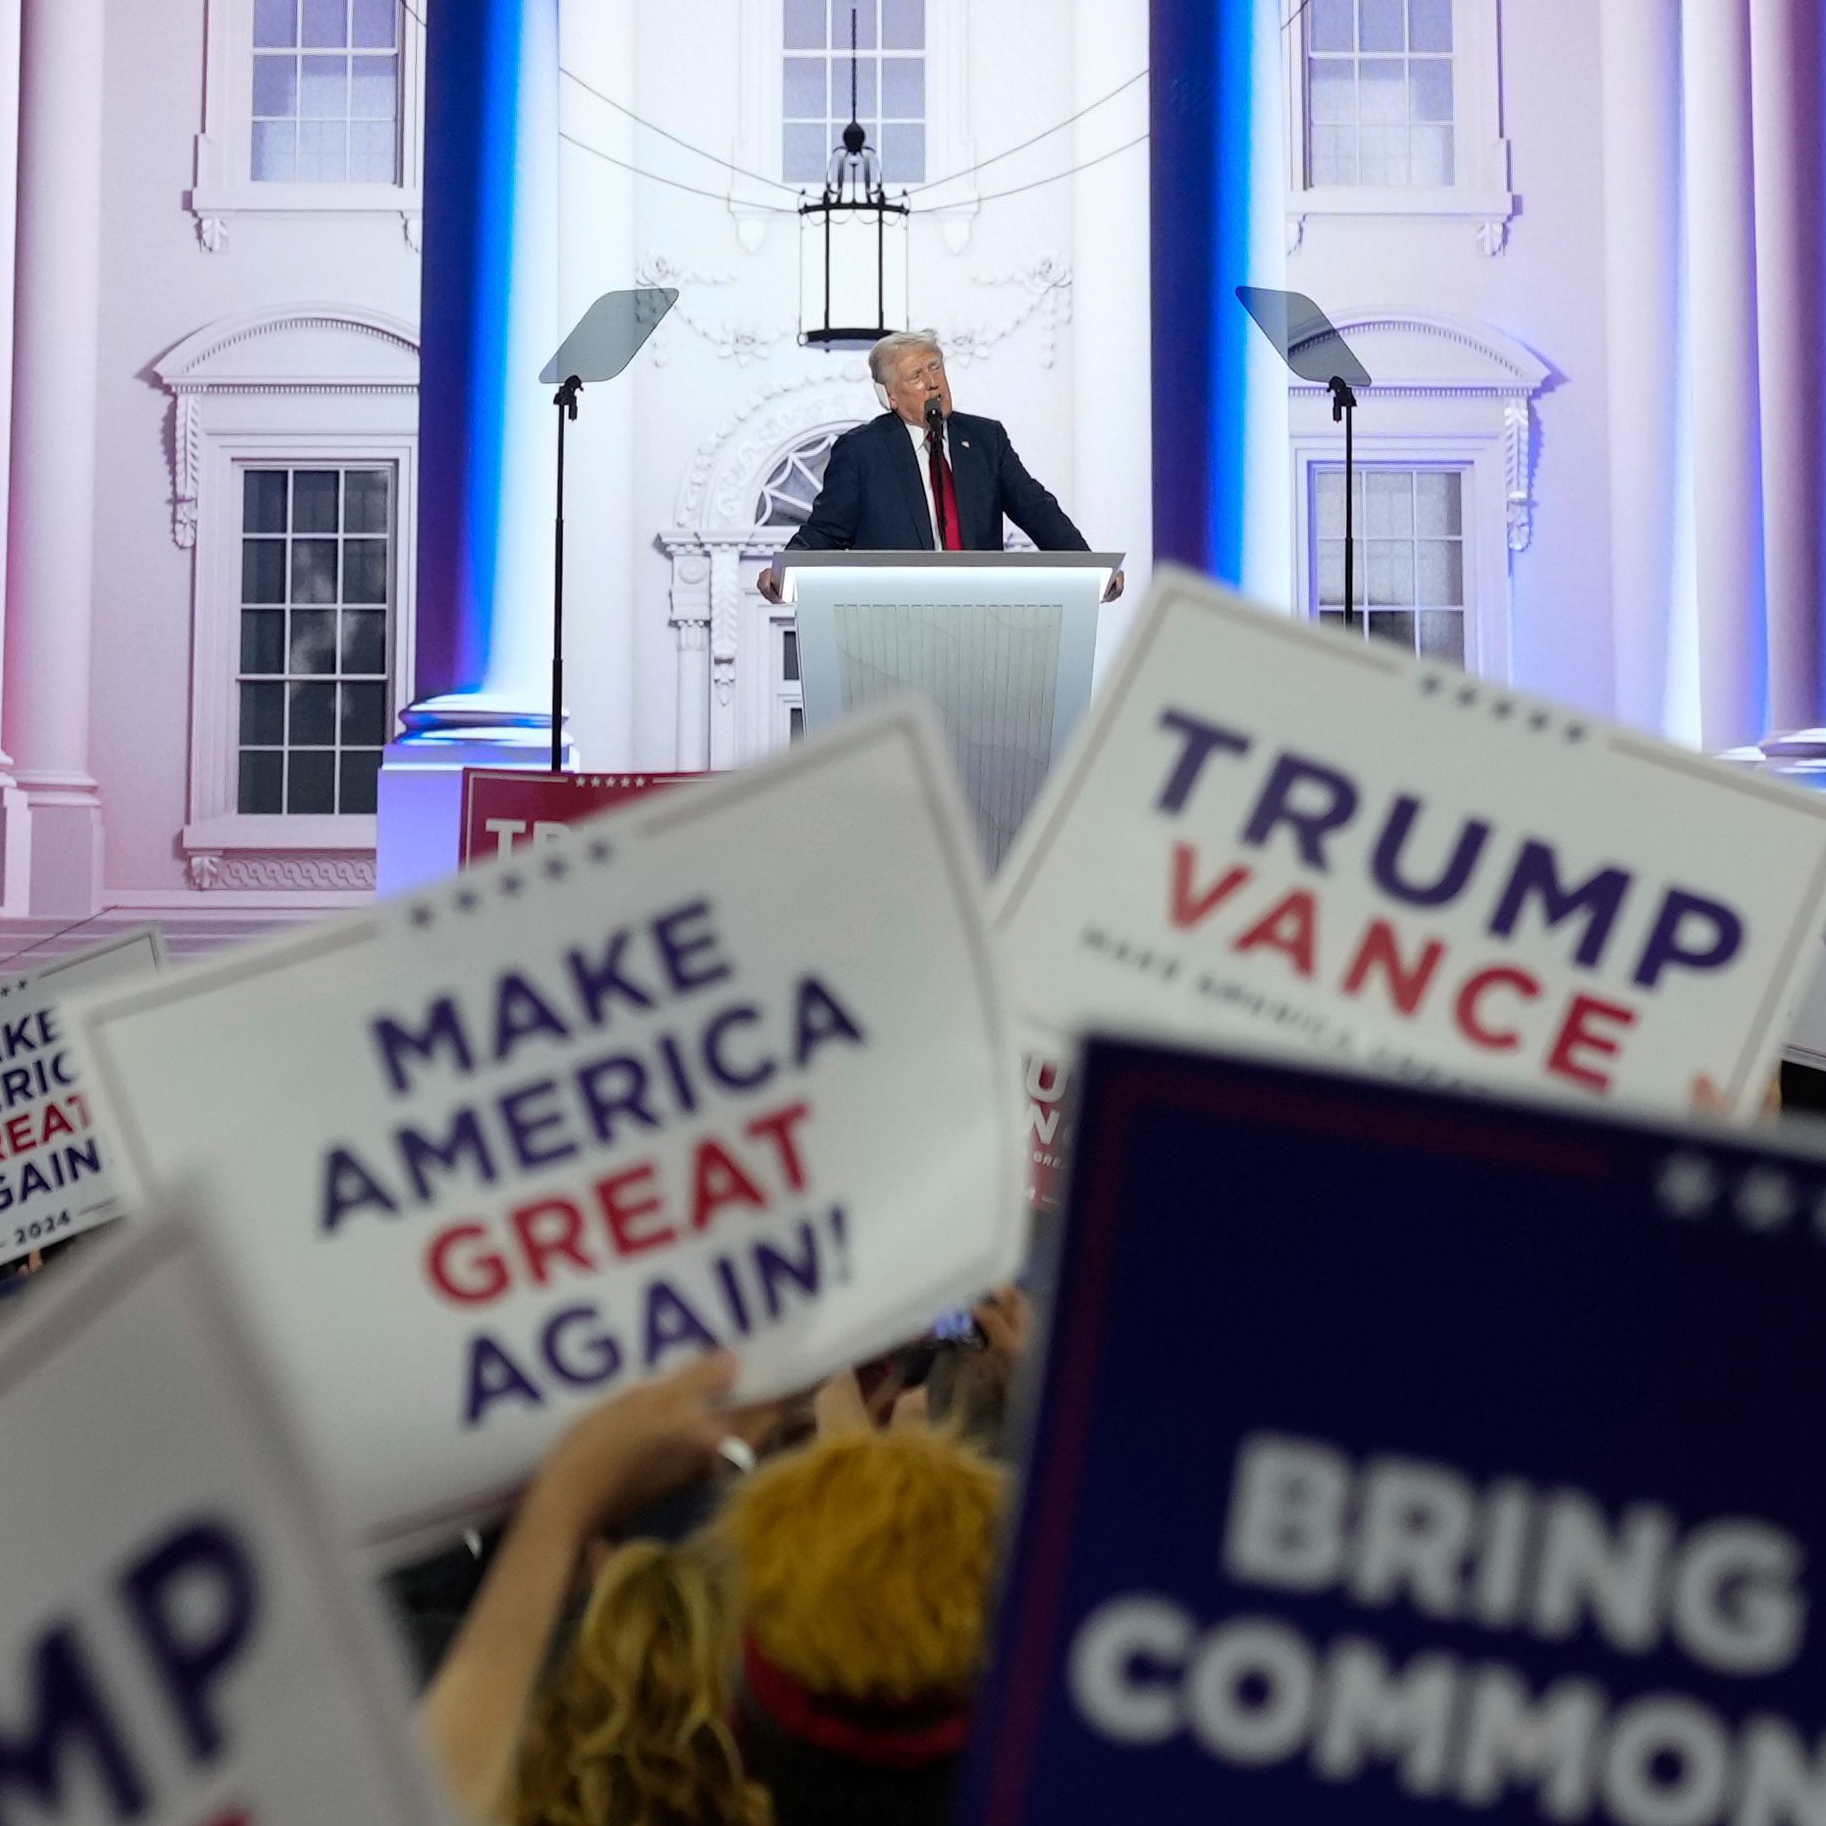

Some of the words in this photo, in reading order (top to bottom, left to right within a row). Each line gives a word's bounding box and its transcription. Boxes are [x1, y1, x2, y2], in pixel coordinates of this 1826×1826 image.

[1155, 705, 1746, 990] TRUMP
[369, 895, 734, 1094] MAKE
[1168, 841, 1638, 1093] VANCE
[317, 972, 864, 1235] AMERICA
[427, 1101, 812, 1305] GREAT
[13, 1210, 70, 1246] 2024
[463, 1204, 852, 1427] AGAIN!
[1224, 1425, 1810, 1677] BRING
